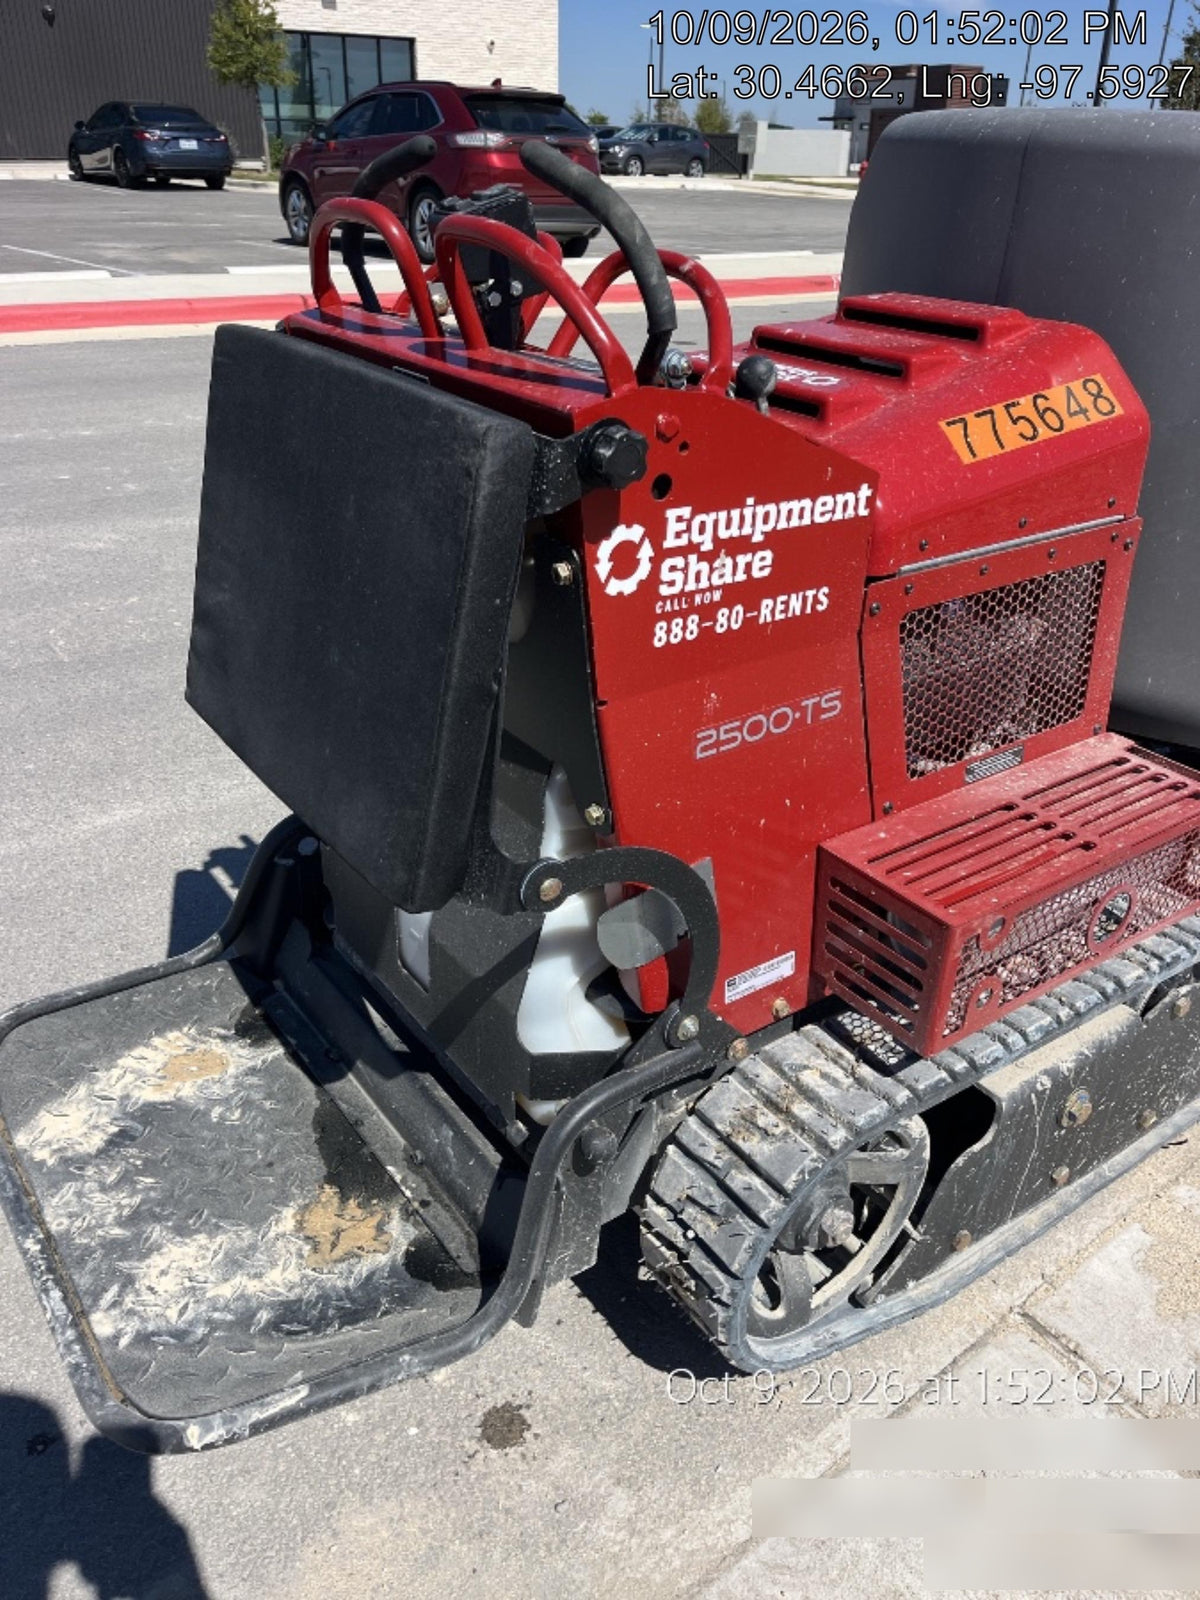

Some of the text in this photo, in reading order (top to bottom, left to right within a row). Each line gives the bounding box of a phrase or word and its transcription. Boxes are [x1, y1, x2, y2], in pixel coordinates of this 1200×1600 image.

[945, 377, 1117, 459] 775648
[662, 483, 872, 551] Equipment
[655, 588, 723, 614] CALL NOW
[659, 549, 773, 596] Share
[653, 586, 830, 648] 888-80-RENTS
